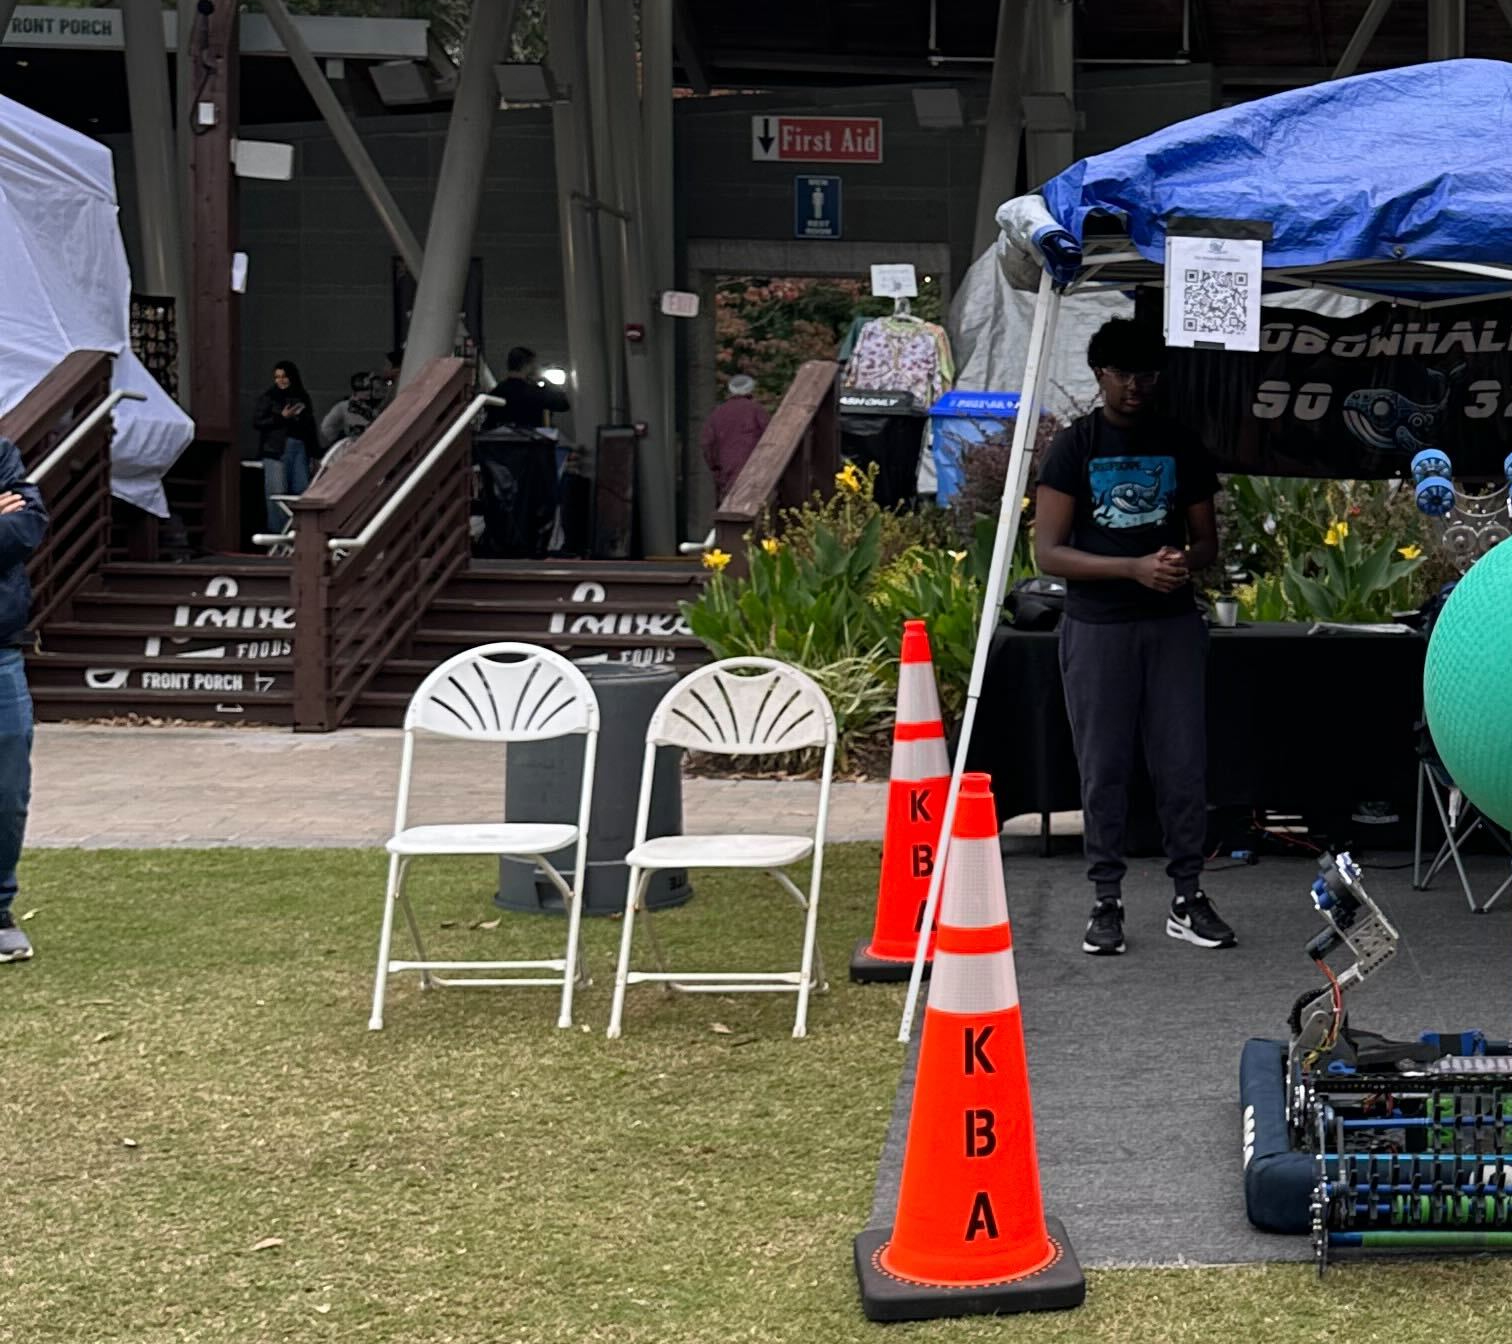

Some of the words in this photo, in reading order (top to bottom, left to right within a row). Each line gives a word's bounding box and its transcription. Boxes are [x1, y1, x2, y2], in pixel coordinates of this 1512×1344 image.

[11, 17, 54, 33] RONT
[60, 19, 112, 35] PORCH
[781, 125, 832, 152] First
[841, 127, 876, 153] Aid
[142, 672, 190, 690] FRONT
[194, 674, 243, 691] PORCH
